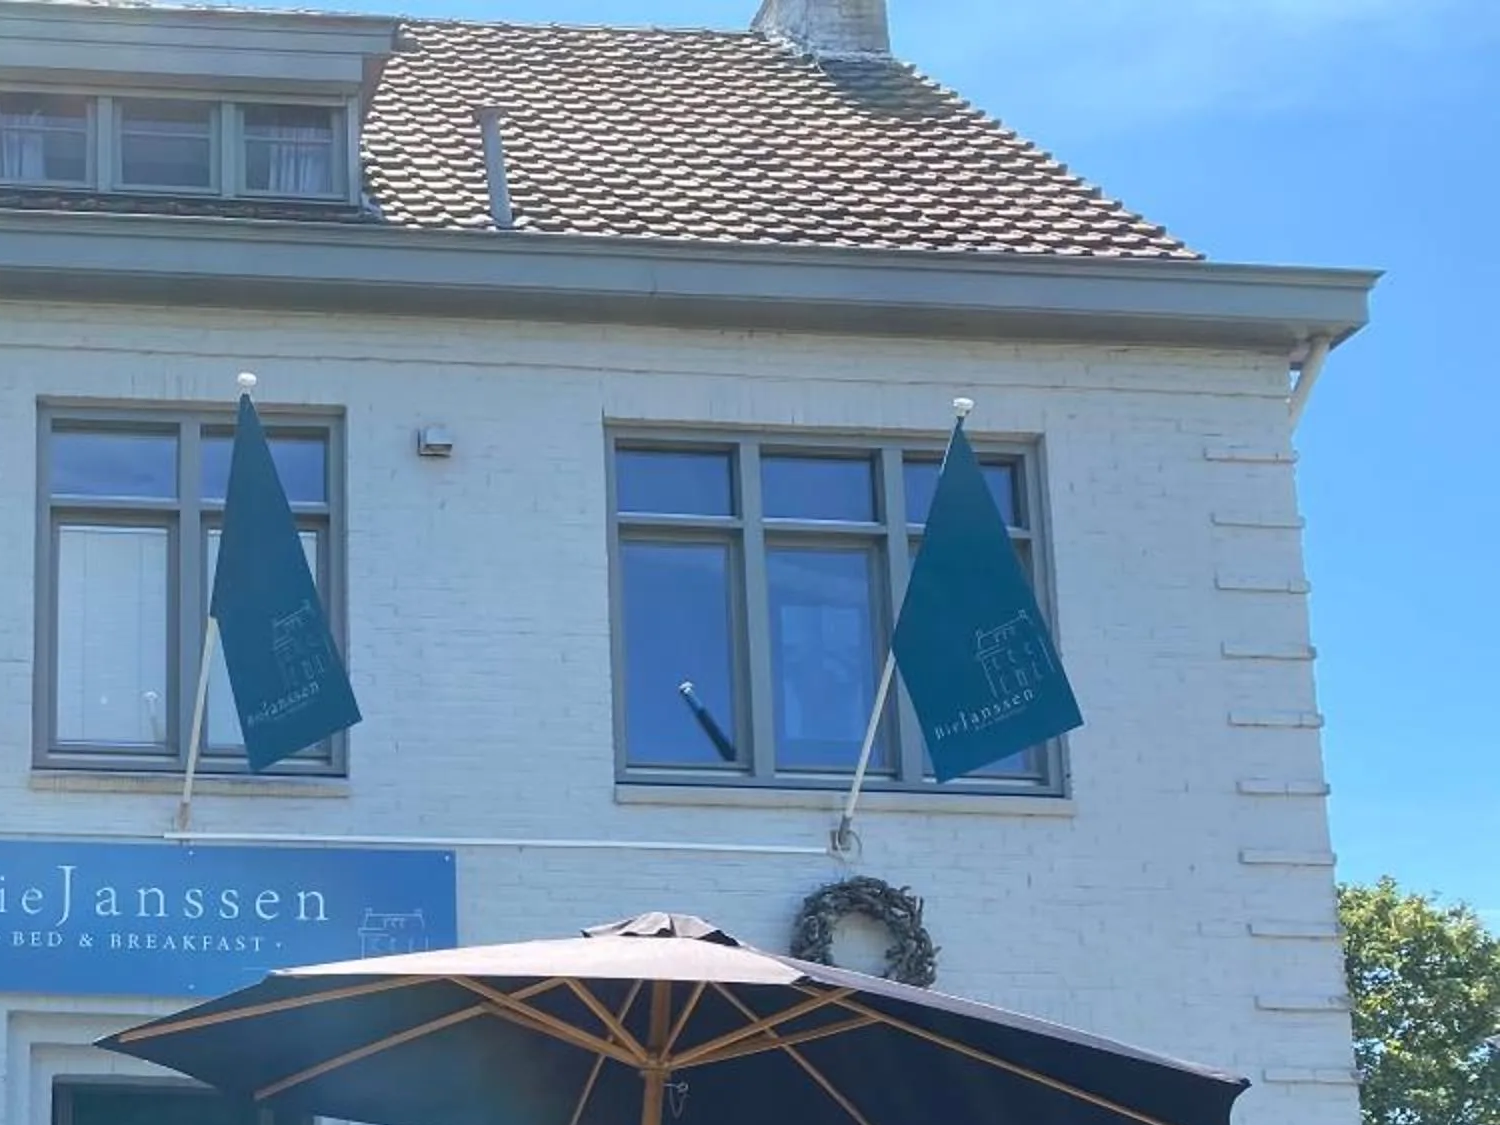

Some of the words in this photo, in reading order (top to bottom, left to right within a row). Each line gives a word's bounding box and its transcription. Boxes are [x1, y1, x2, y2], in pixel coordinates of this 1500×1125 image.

[11, 930, 63, 948] BED
[78, 932, 94, 948] &
[110, 933, 266, 953] BREAKFAST
